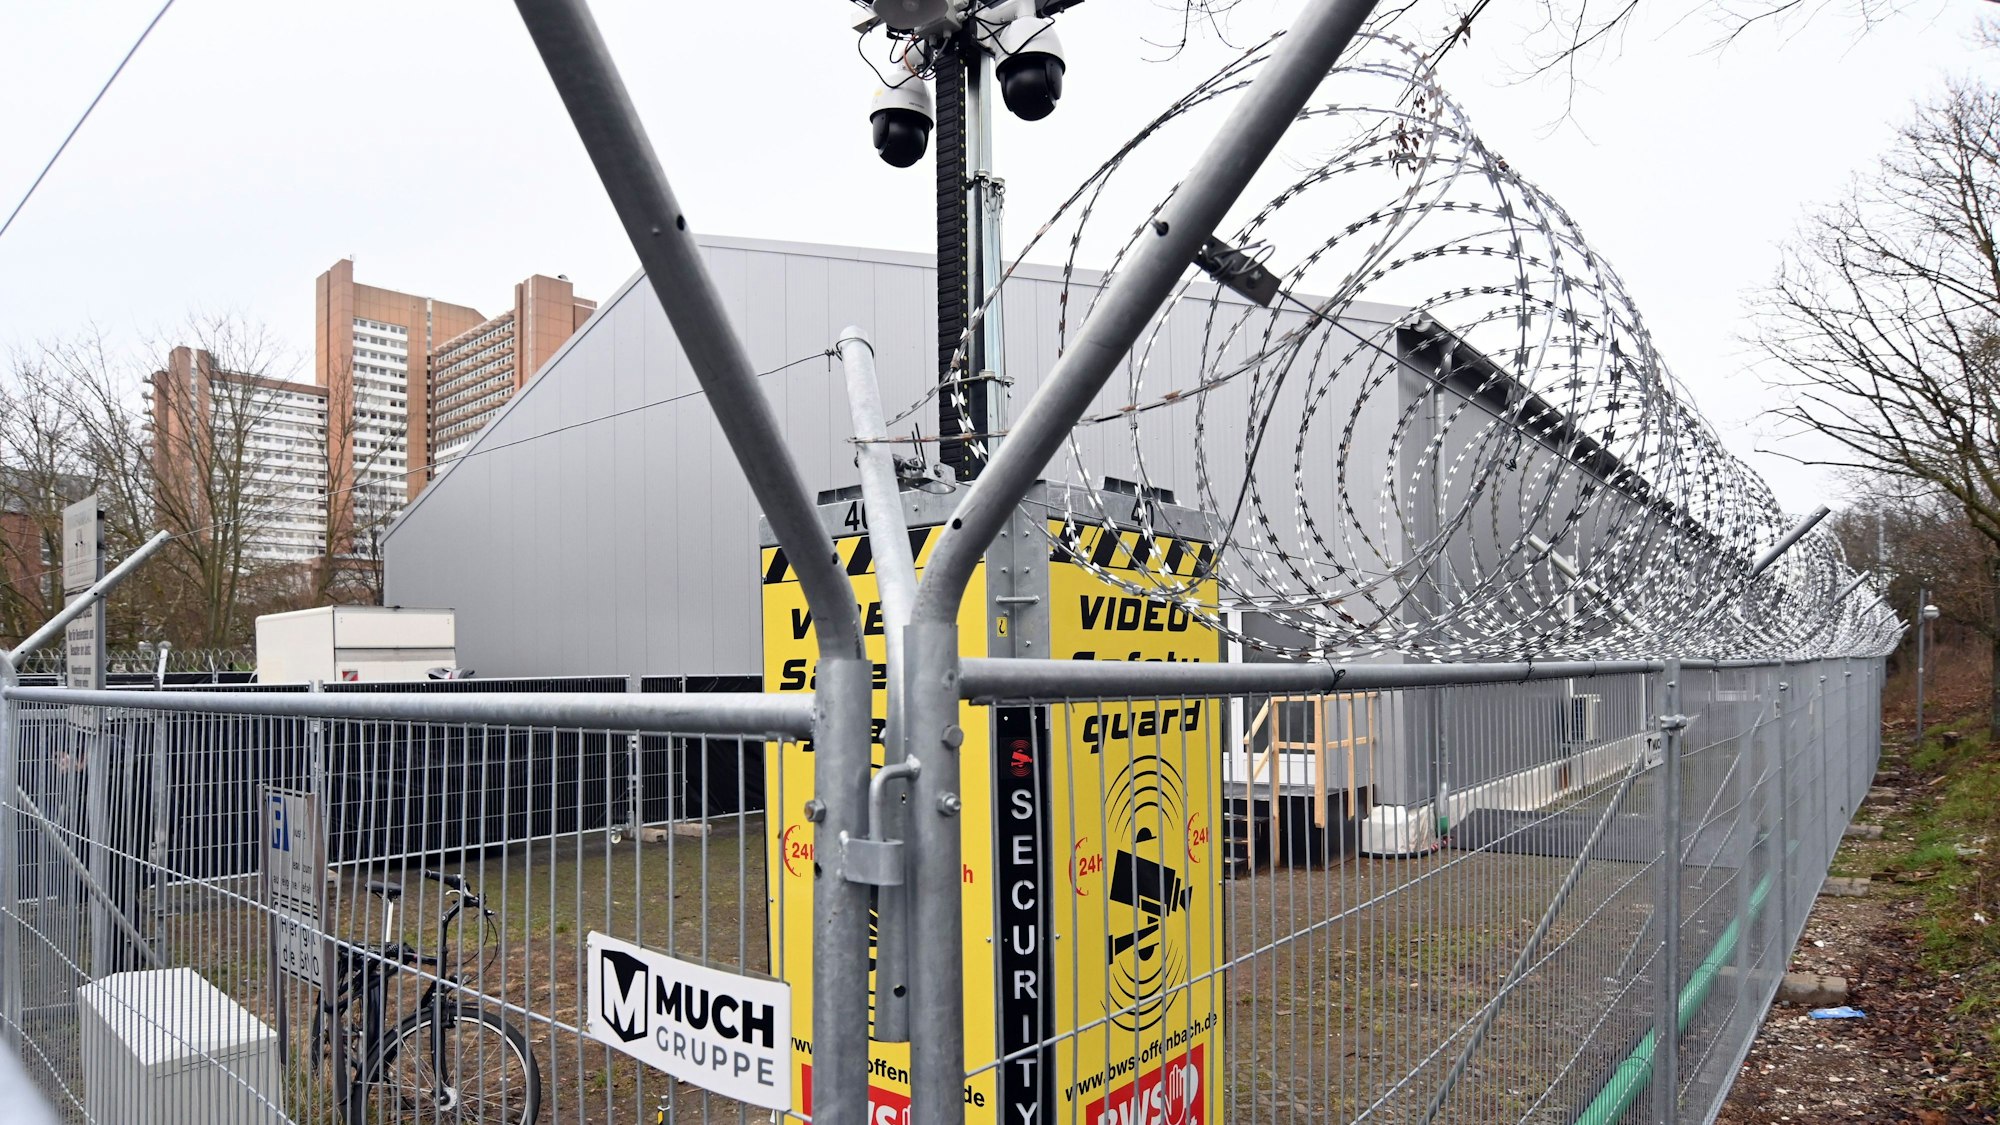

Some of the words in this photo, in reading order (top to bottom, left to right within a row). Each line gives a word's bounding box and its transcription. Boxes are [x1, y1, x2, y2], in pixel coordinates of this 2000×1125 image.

[1082, 700, 1201, 754] guard
[282, 944, 296, 966] de
[1011, 788, 1038, 1125] SECURITY
[656, 975, 774, 1049] MUCH
[656, 1025, 774, 1087] GRUPPE
